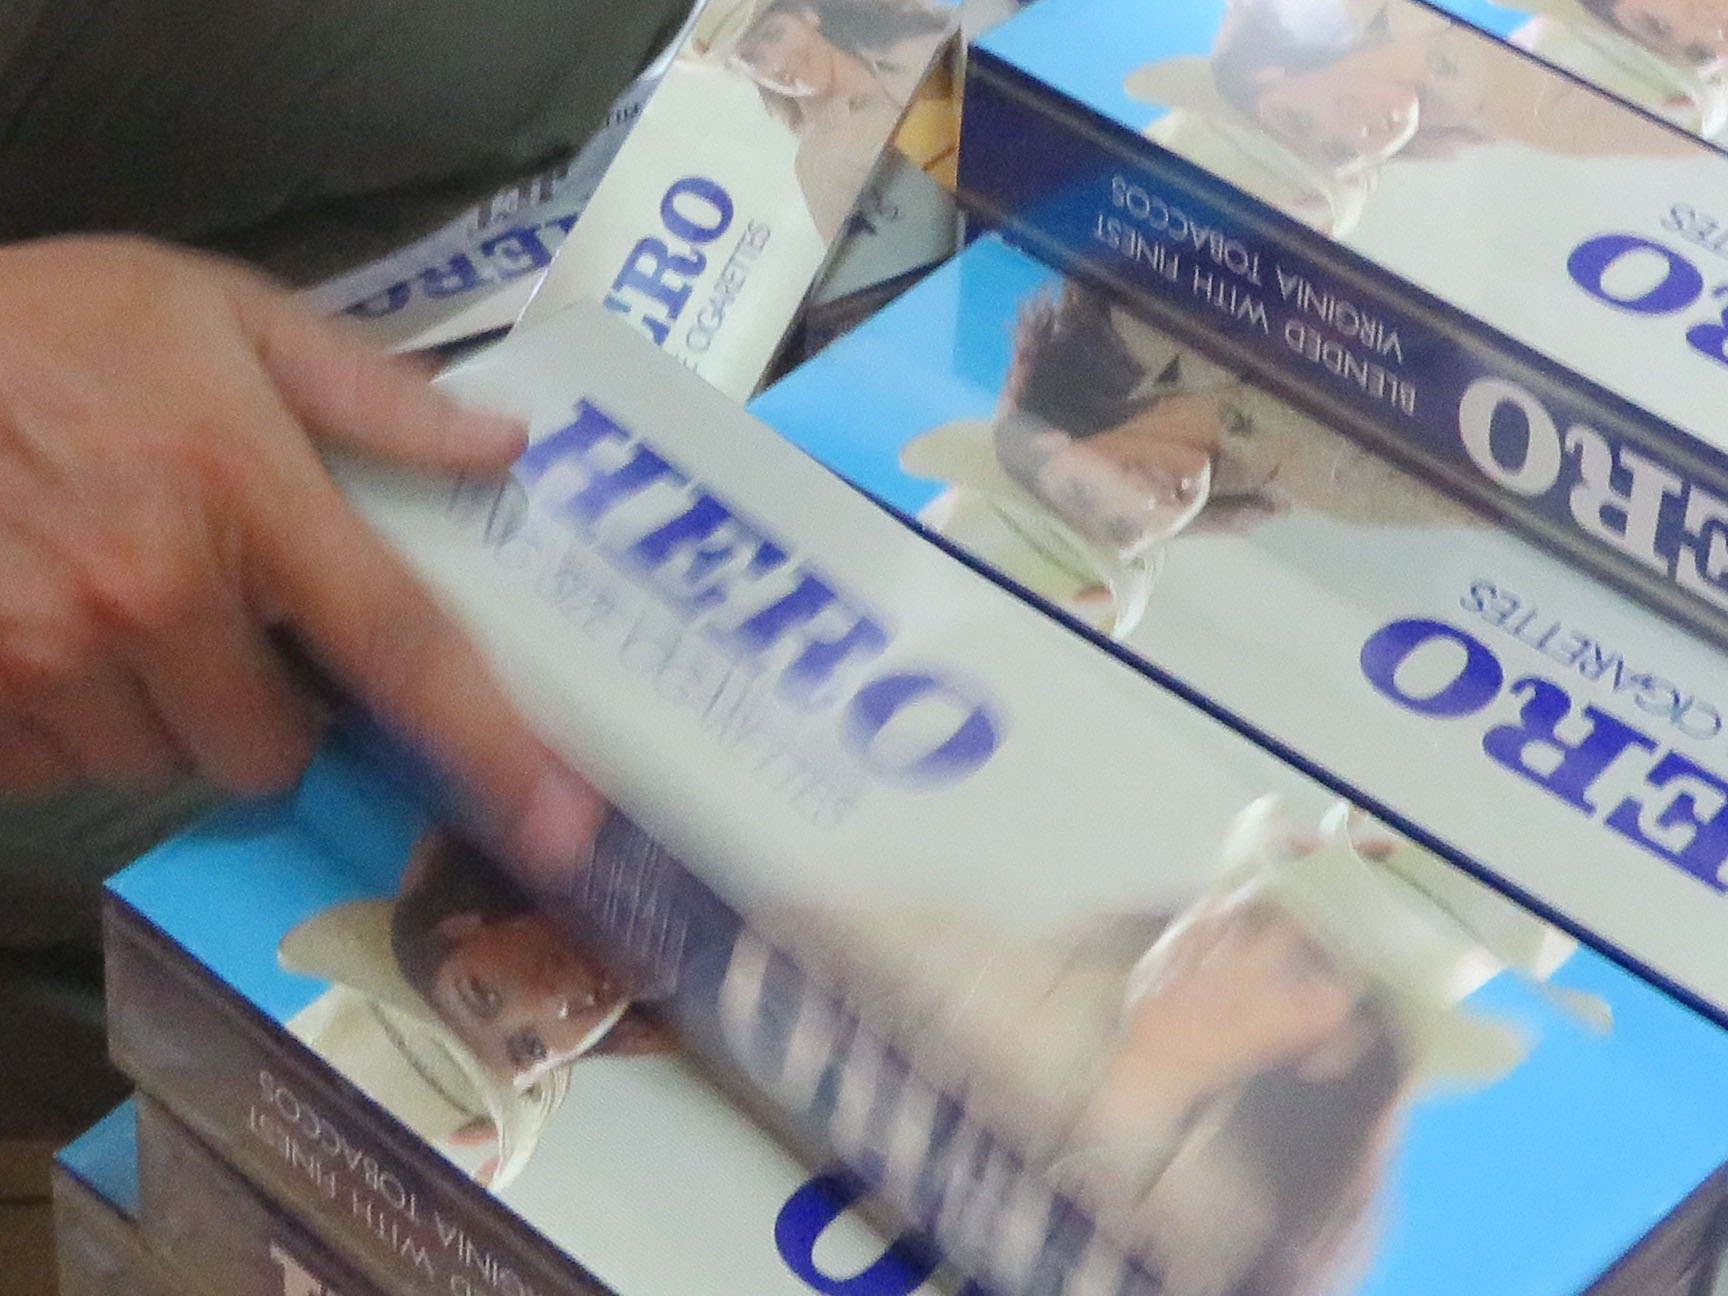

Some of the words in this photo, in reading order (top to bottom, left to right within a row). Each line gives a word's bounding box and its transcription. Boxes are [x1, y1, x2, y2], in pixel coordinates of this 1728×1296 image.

[1091, 211, 1183, 285] FINEST
[1110, 174, 1264, 281] TOBACCOS
[685, 218, 772, 359] CIGARETTES
[1190, 265, 1273, 340] WITH
[1273, 270, 1408, 365] VIRGINIA
[1285, 317, 1418, 418] BLENDED
[509, 393, 1012, 793] HERO
[1459, 576, 1723, 740] CIGARETTES
[258, 1069, 417, 1222] TOBACCOS
[351, 1190, 436, 1282] WITH
